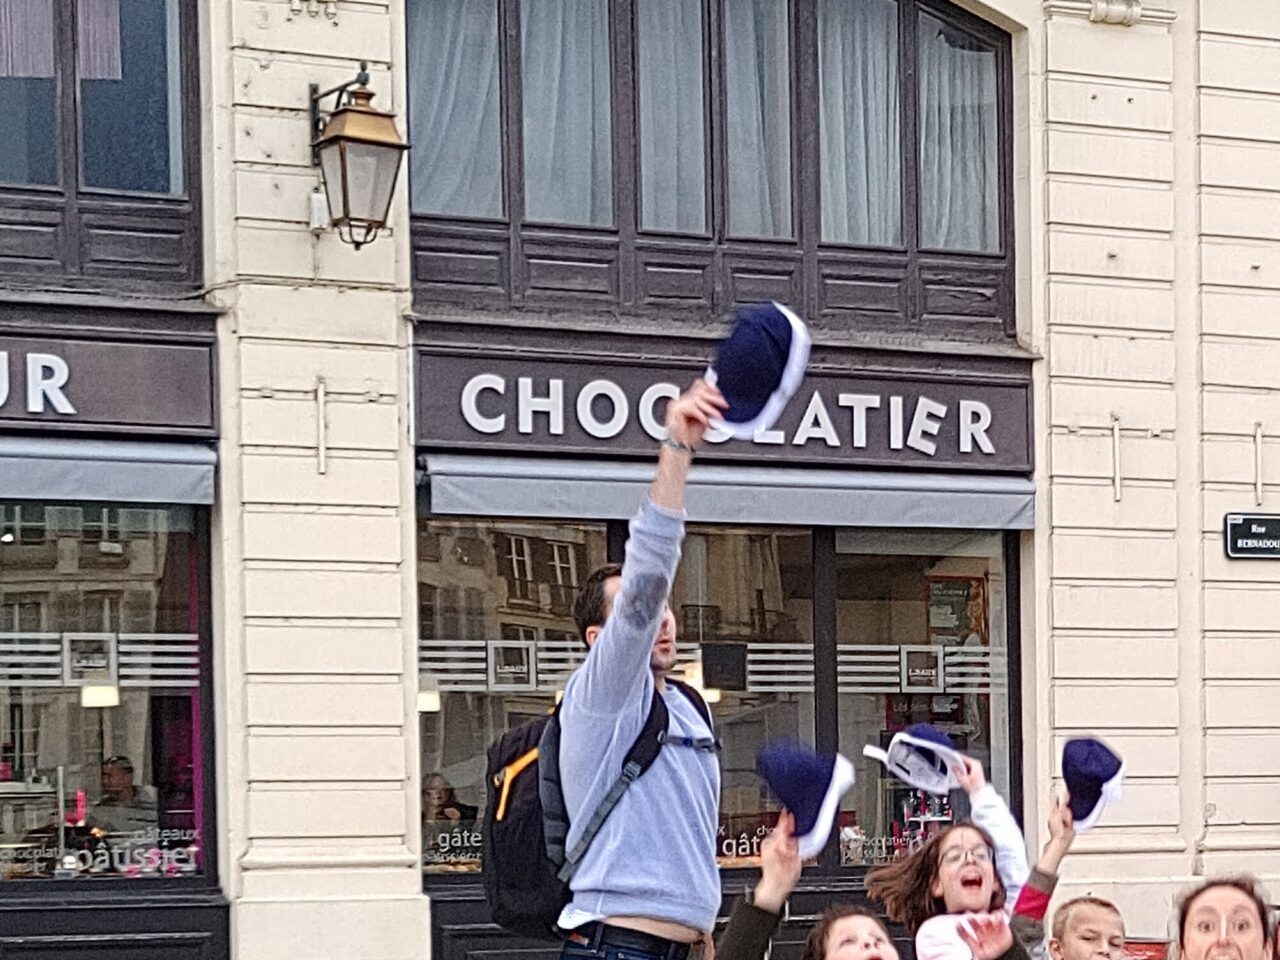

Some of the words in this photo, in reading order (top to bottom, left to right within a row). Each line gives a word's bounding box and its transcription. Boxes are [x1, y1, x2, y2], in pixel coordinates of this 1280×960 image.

[0, 351, 78, 414] R
[460, 373, 997, 456] CHOCATIER
[1251, 524, 1266, 533] Rue
